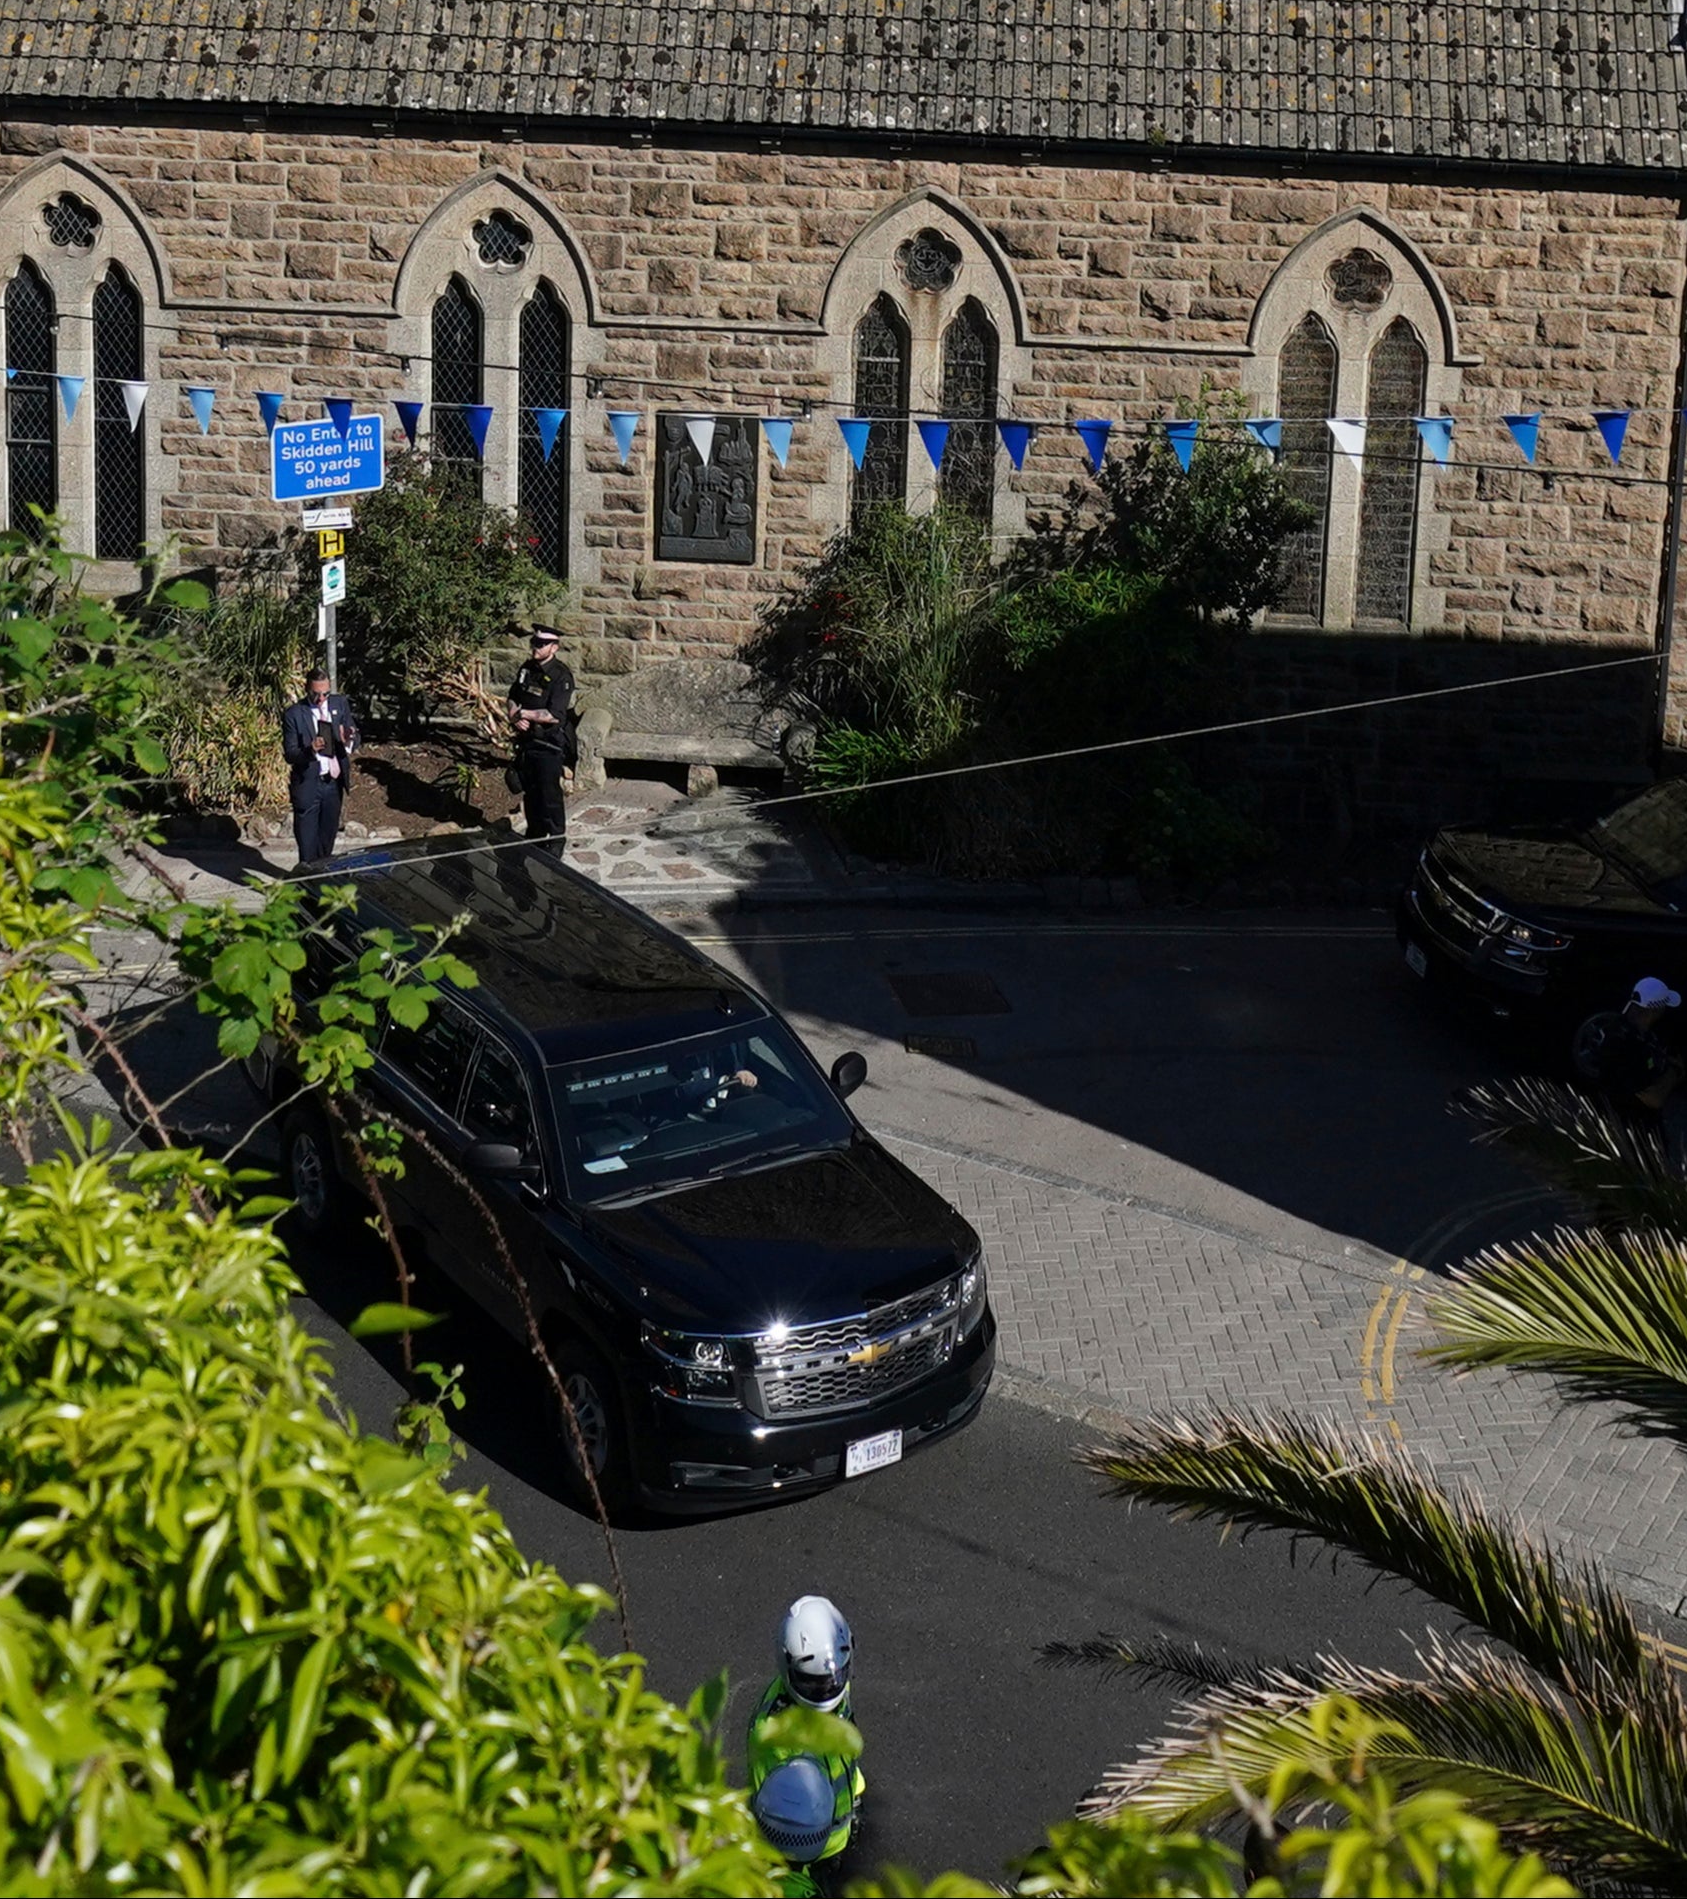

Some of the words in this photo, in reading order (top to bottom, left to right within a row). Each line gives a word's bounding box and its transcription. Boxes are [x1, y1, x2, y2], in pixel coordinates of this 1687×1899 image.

[282, 431, 305, 444] No
[355, 423, 372, 436] to
[281, 443, 342, 460] Skidden
[348, 437, 374, 452] Hill
[295, 460, 315, 475] 50
[320, 456, 361, 474] yards
[306, 472, 350, 489] ahead
[323, 531, 340, 554] H
